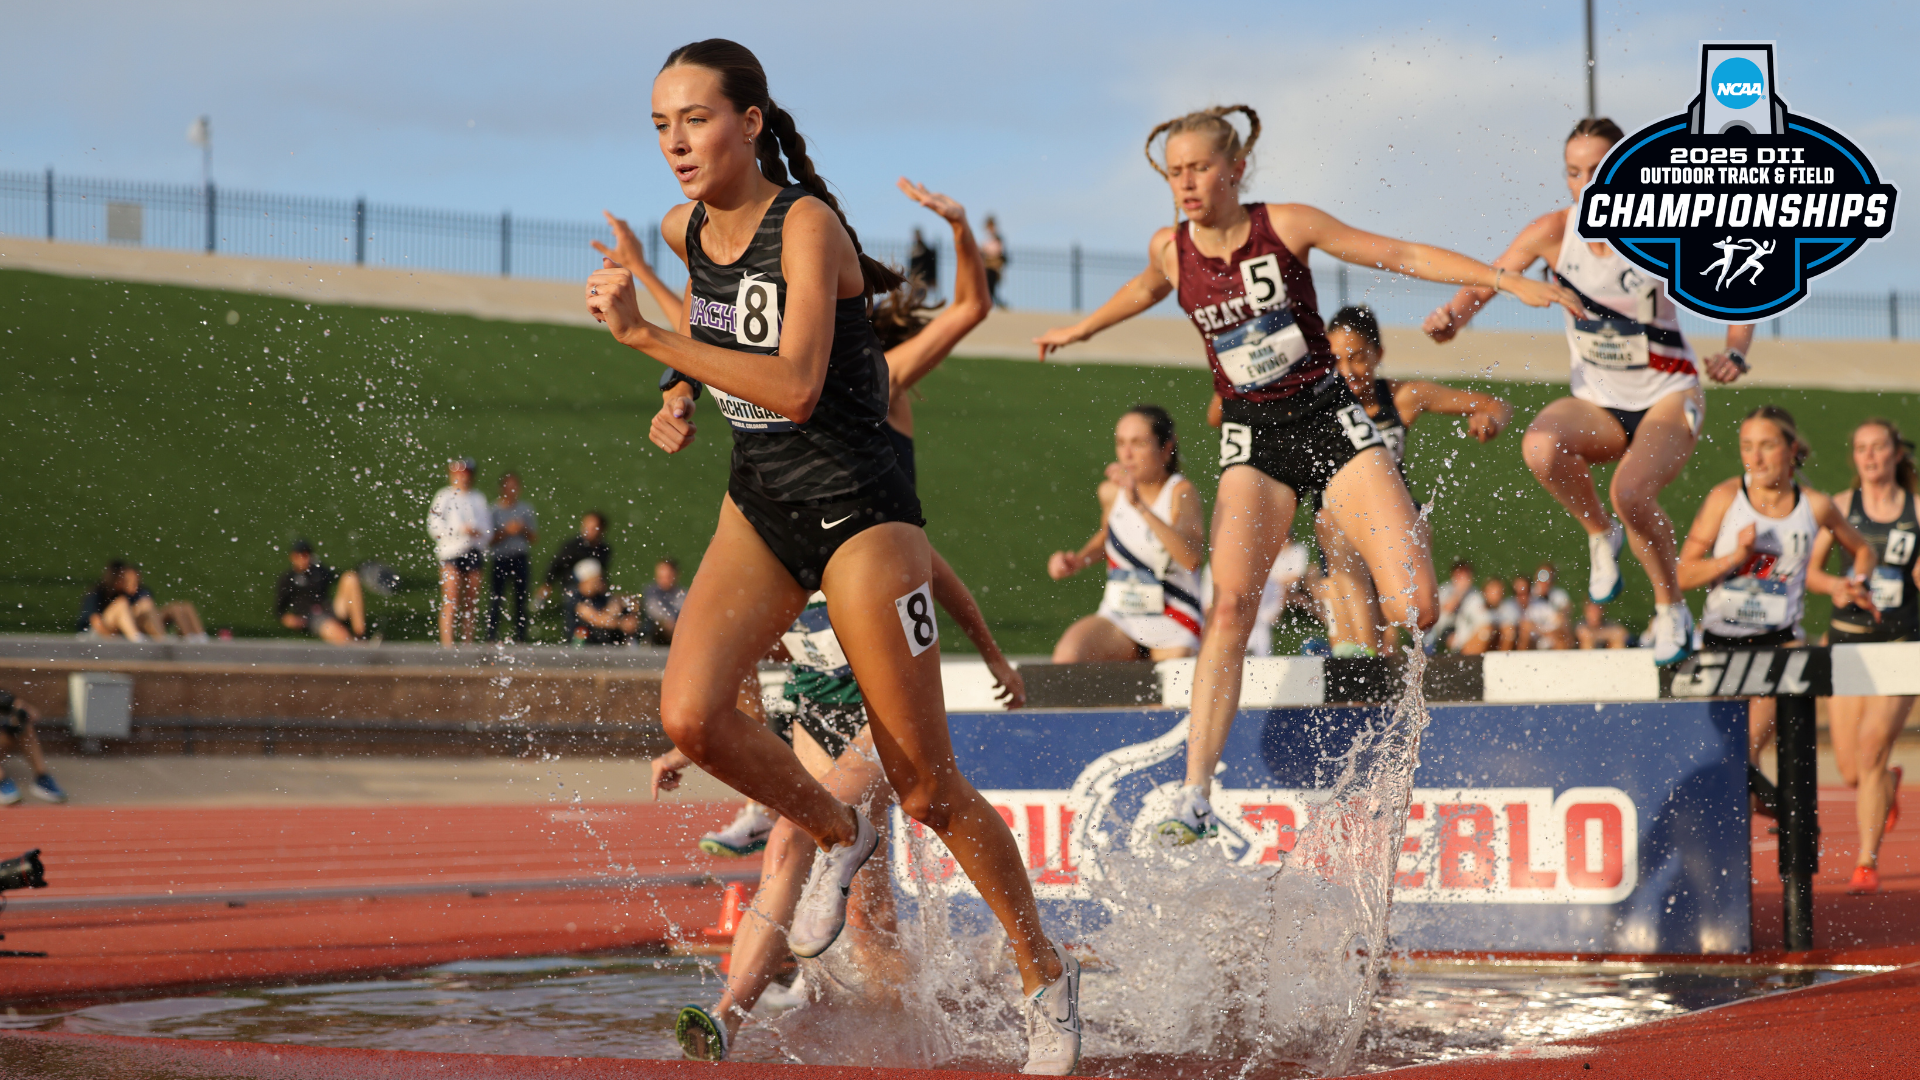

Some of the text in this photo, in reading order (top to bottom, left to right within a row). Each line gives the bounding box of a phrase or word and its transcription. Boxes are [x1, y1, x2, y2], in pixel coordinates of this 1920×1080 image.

[1249, 260, 1276, 303] 5
[743, 284, 769, 343] 8
[1246, 352, 1288, 378] EWING
[1347, 407, 1374, 442] 5
[1223, 428, 1244, 461] 5
[1892, 536, 1907, 562] 4
[907, 592, 934, 647] 8
[1671, 651, 1811, 697] GILL
